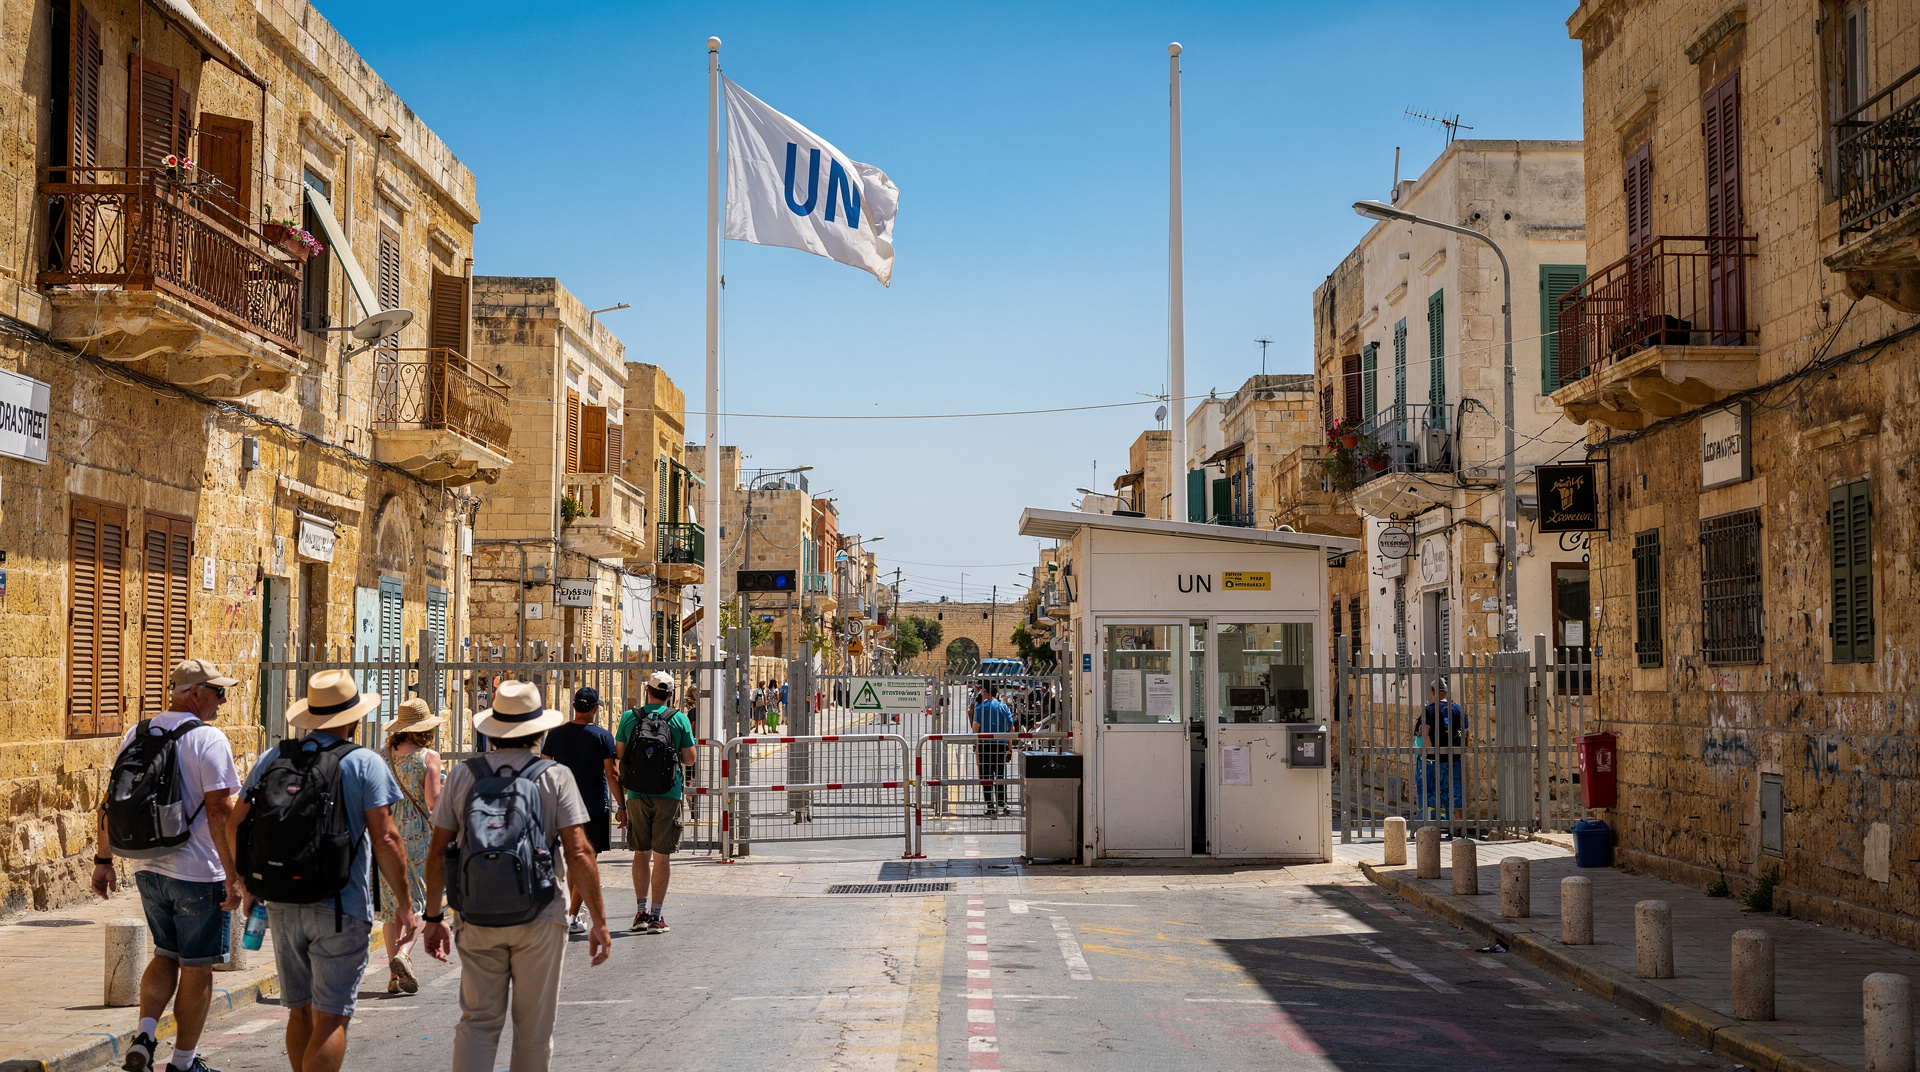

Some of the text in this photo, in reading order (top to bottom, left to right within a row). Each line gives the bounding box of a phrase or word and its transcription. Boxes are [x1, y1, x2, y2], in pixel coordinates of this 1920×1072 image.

[784, 142, 861, 229] UN
[18, 406, 47, 440] STREET
[1178, 574, 1211, 593] UN
